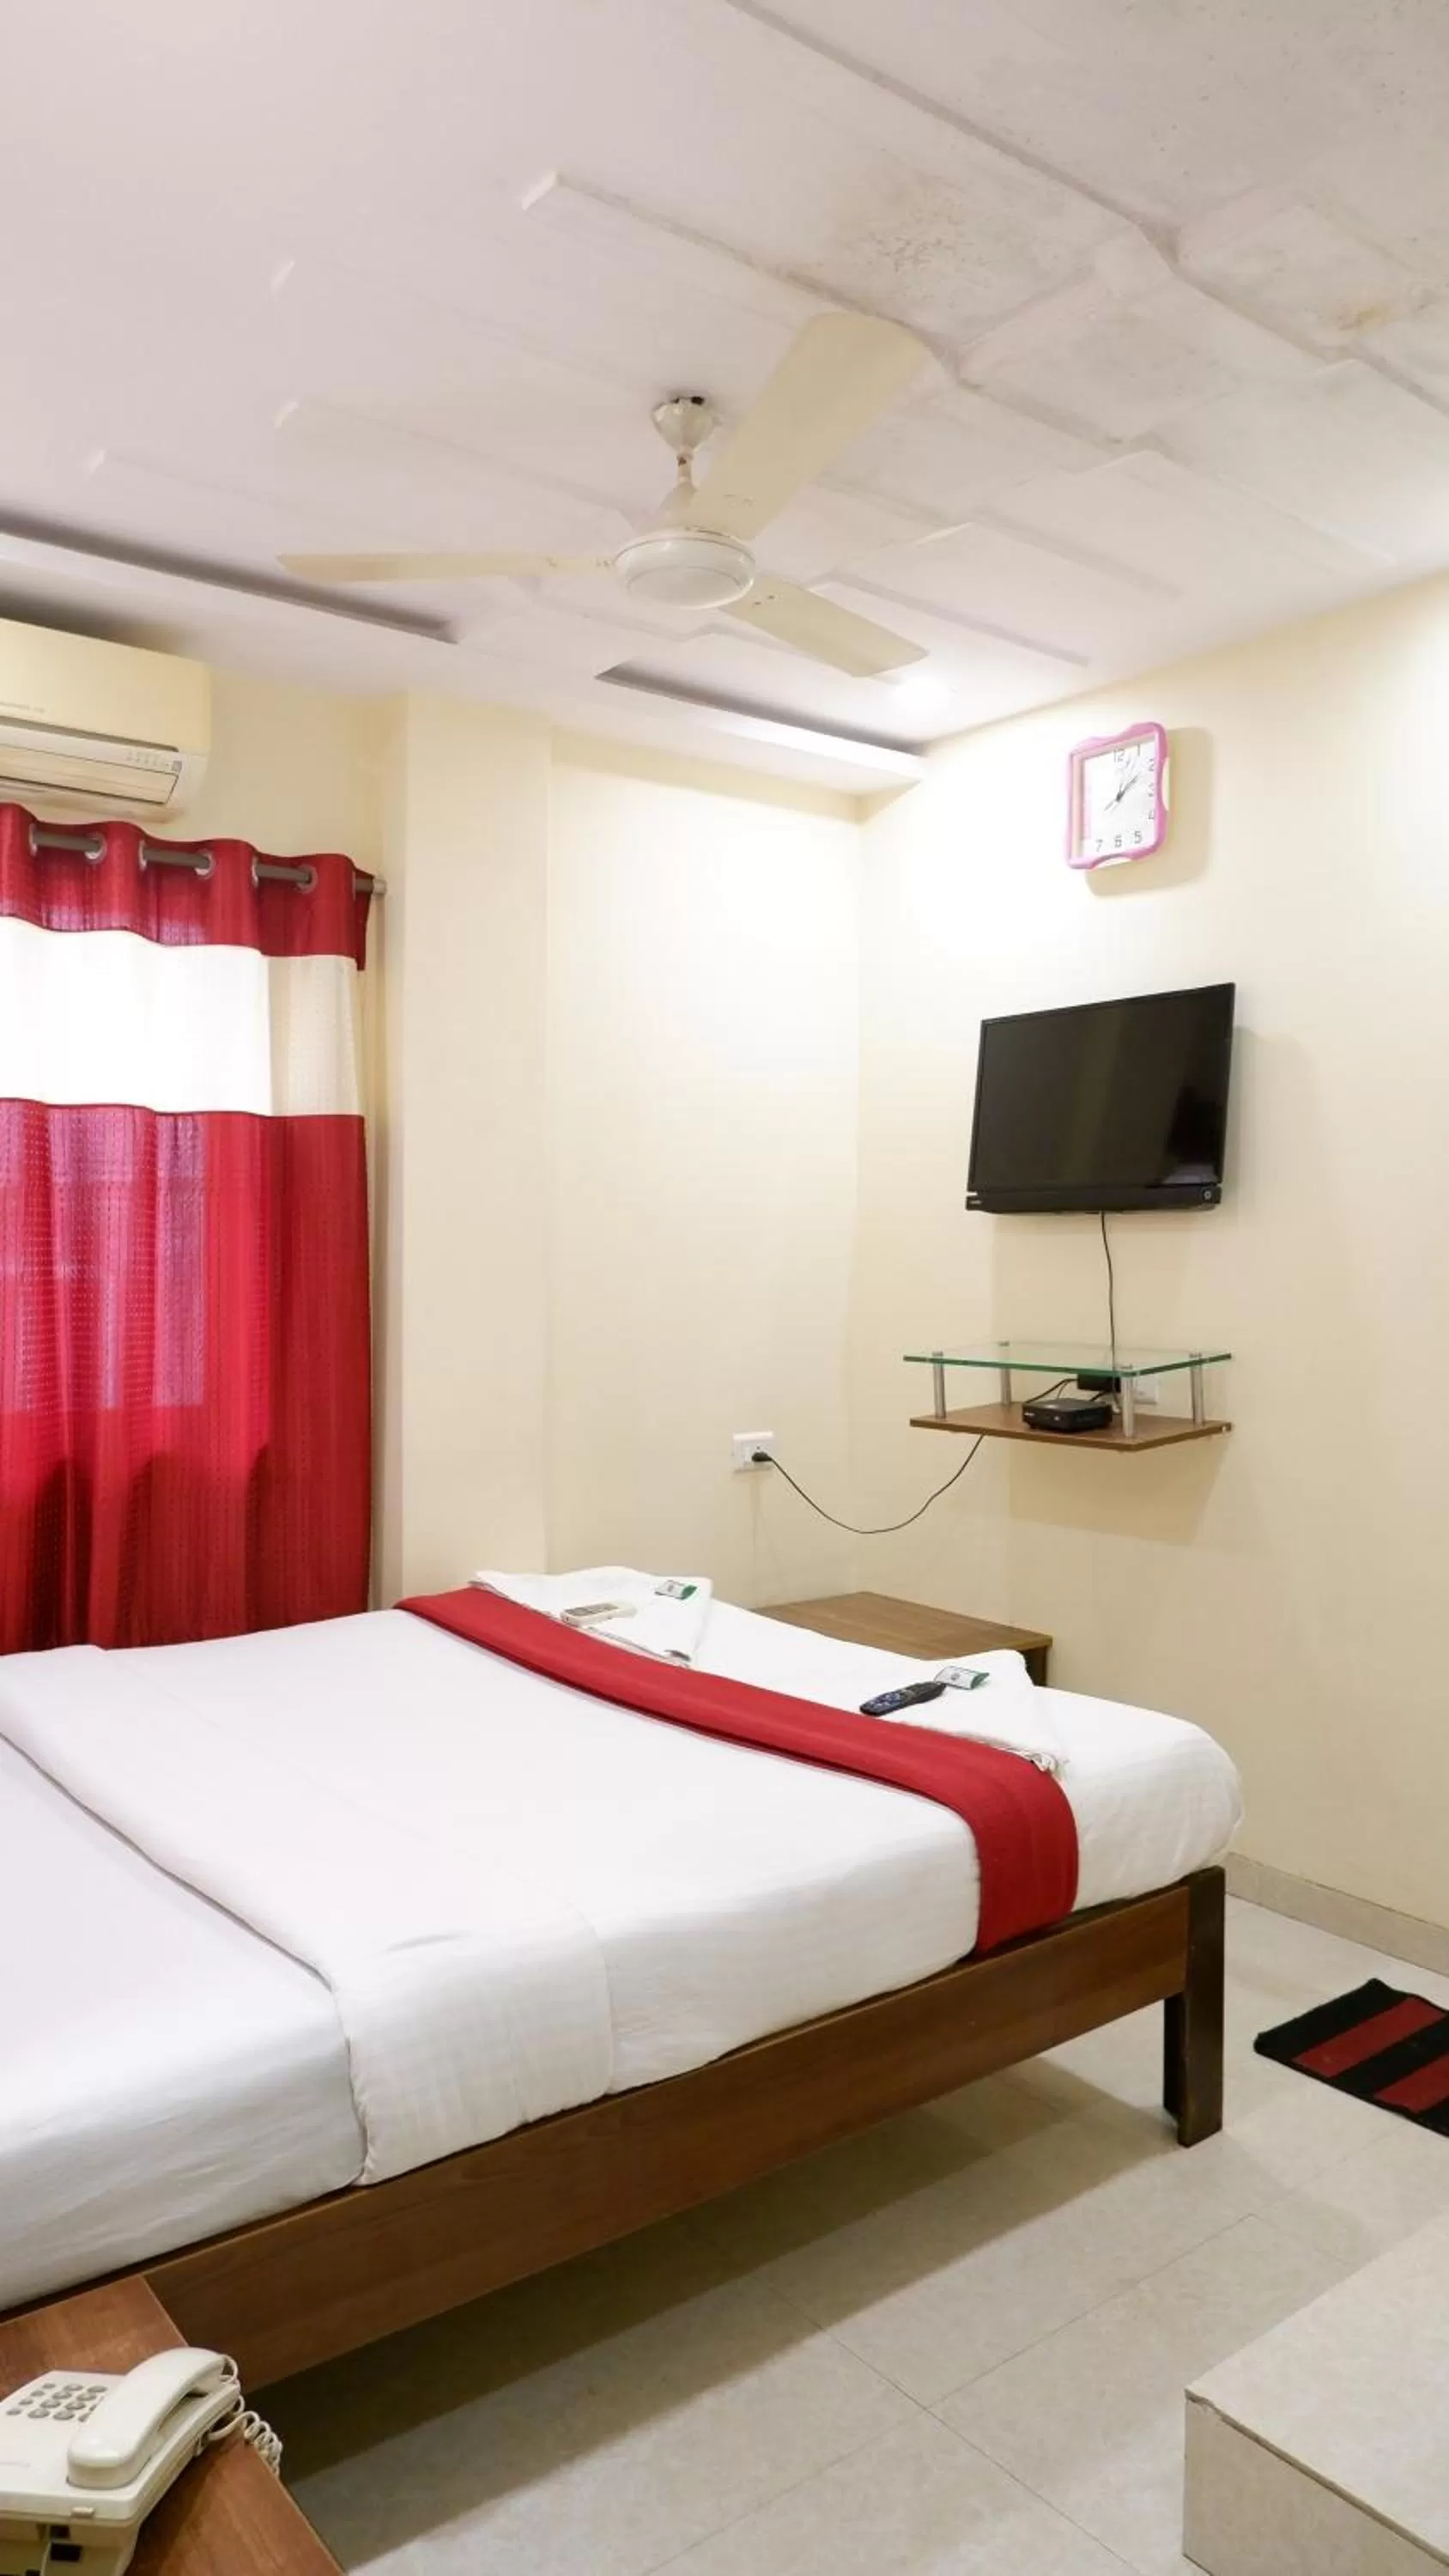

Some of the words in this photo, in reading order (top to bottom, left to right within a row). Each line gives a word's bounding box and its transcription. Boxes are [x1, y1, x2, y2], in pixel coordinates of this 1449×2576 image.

[1113, 748, 1125, 762] 12
[1114, 835, 1122, 848] 6
[1134, 830, 1143, 844] 5
[1095, 839, 1103, 853] 7
